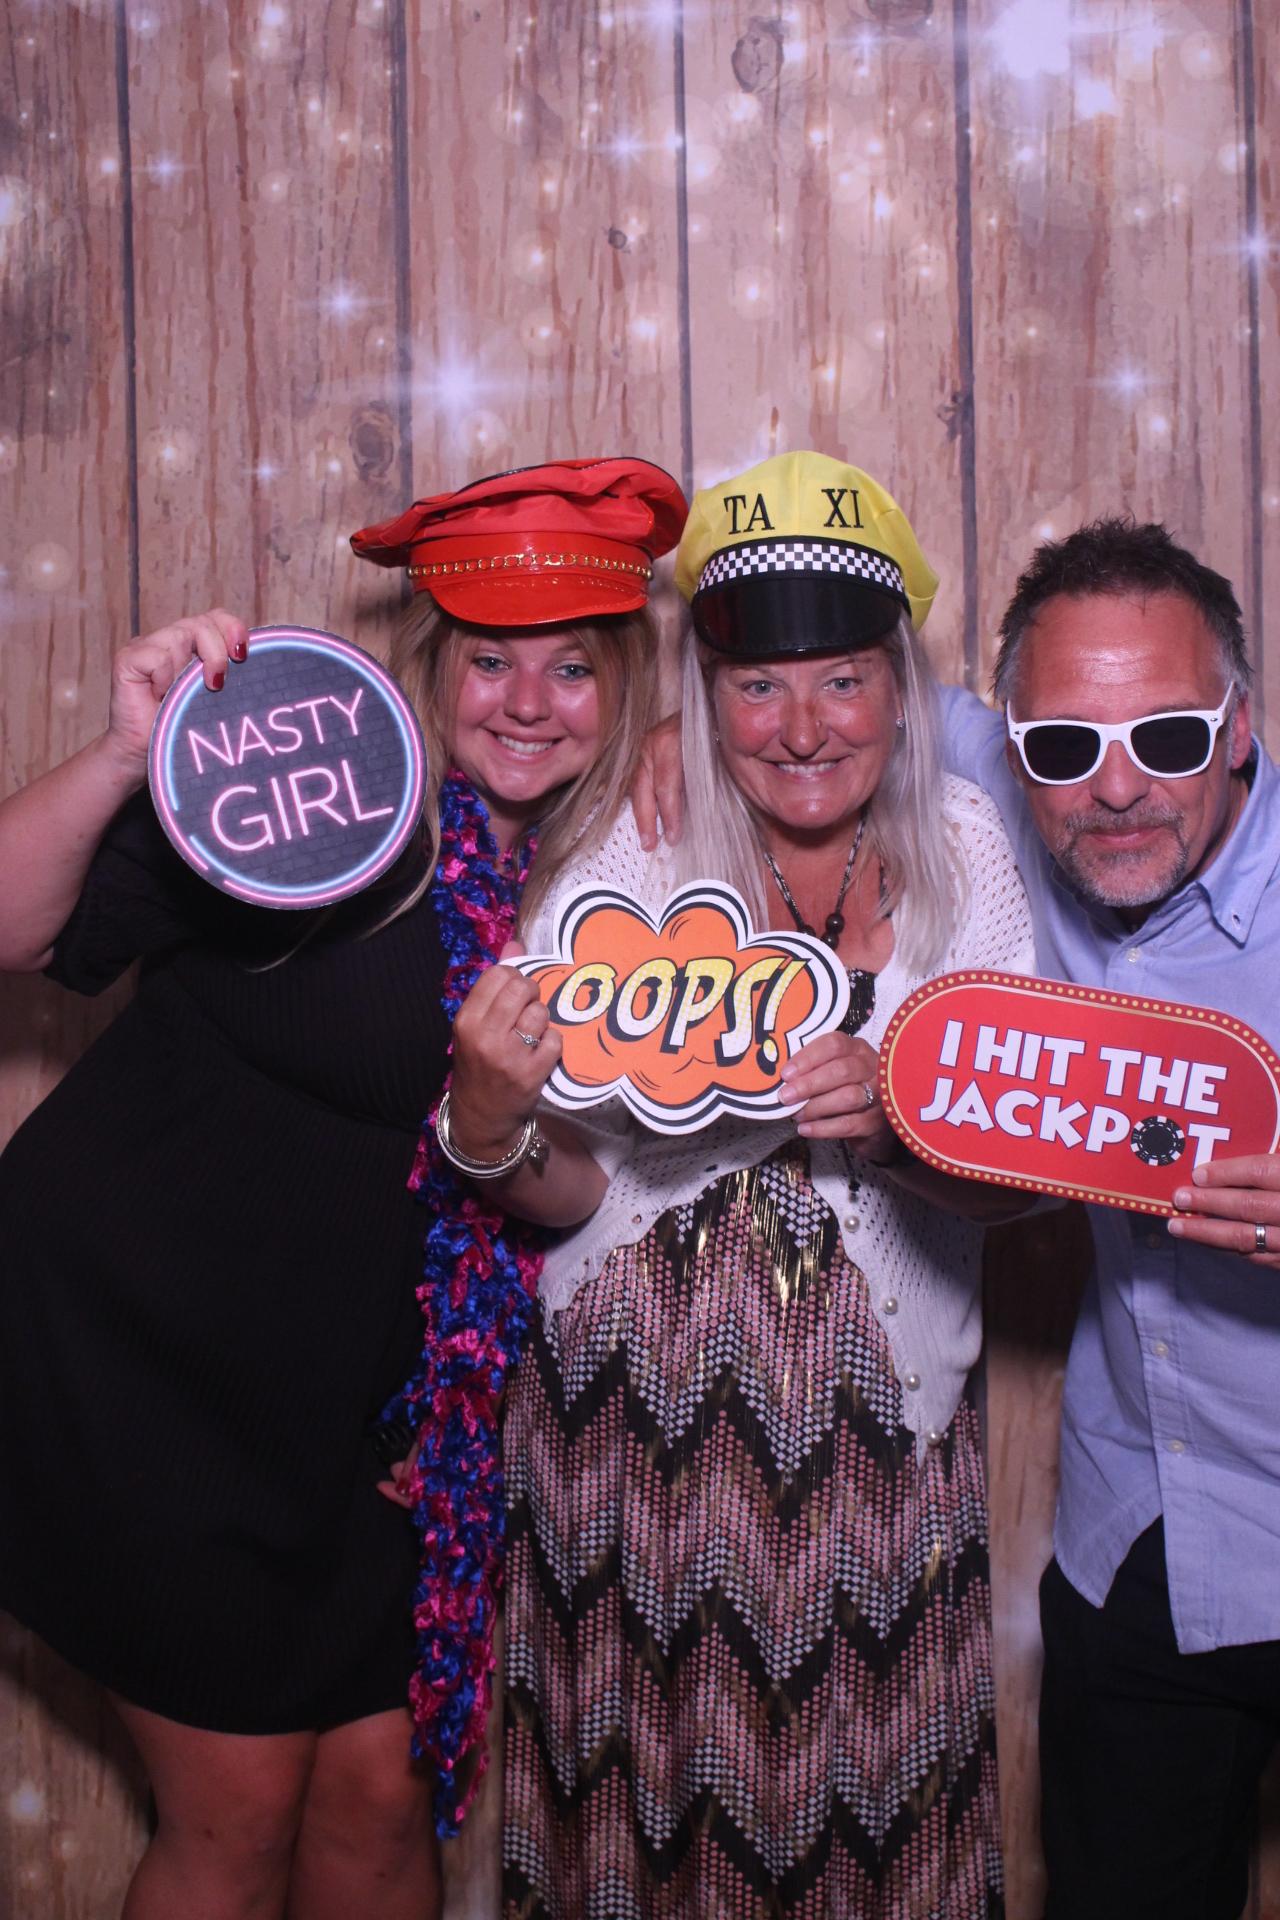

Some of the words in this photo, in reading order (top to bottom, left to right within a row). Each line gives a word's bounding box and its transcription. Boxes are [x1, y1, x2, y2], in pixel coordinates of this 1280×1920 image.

[188, 688, 363, 774] NASTY
[212, 759, 394, 851] GIRL
[547, 957, 812, 1076] OOPS!
[939, 1019, 964, 1067] I
[973, 1025, 1086, 1087] HIT
[1100, 1046, 1228, 1115] THE
[919, 1076, 1231, 1169] JACKPOT
